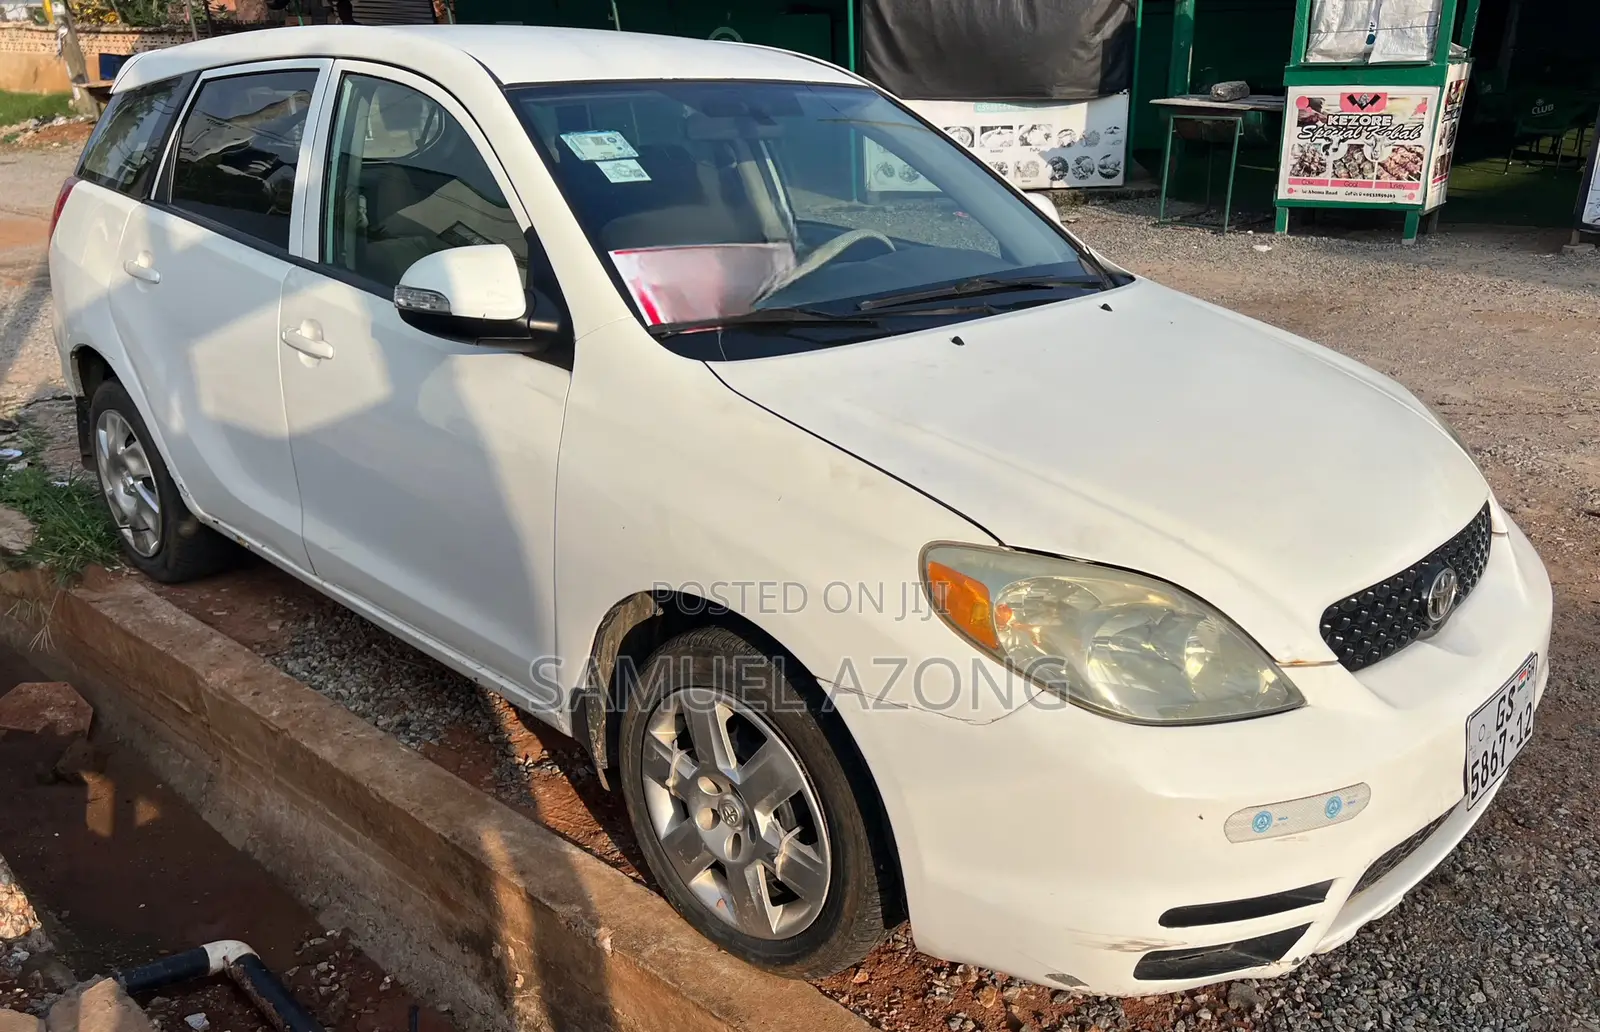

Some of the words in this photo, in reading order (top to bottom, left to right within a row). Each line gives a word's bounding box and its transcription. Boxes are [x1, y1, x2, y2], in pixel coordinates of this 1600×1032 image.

[1532, 104, 1554, 115] CLUB
[1327, 114, 1393, 127] KEZORE
[1298, 124, 1362, 142] Special
[1365, 124, 1424, 140] Kebab
[1496, 685, 1516, 732] GS
